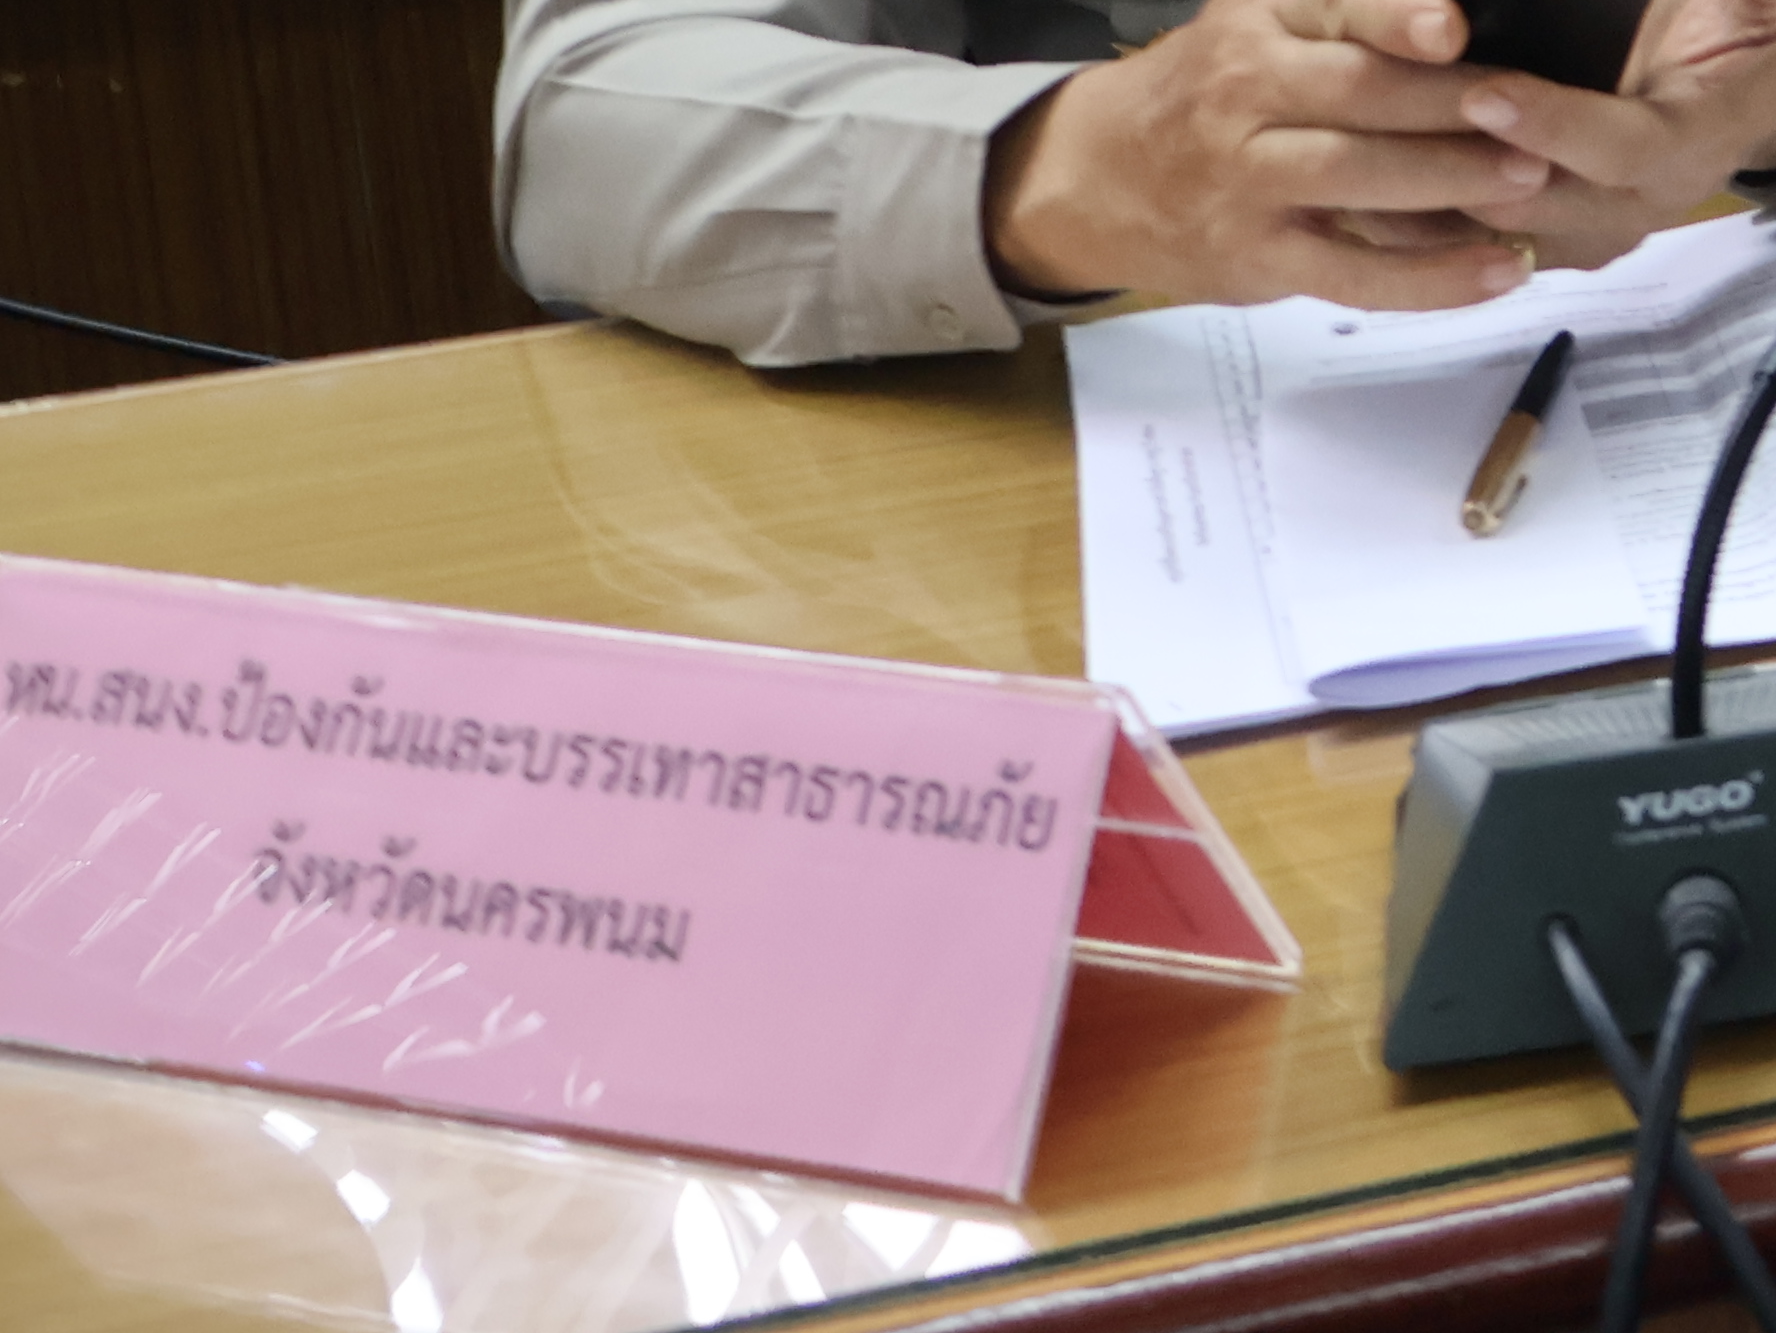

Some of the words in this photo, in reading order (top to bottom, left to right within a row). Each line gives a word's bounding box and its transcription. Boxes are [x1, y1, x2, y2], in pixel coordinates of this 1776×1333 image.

[1616, 779, 1756, 826] YUGO
[253, 820, 691, 963] จังหวัดนครพนม
